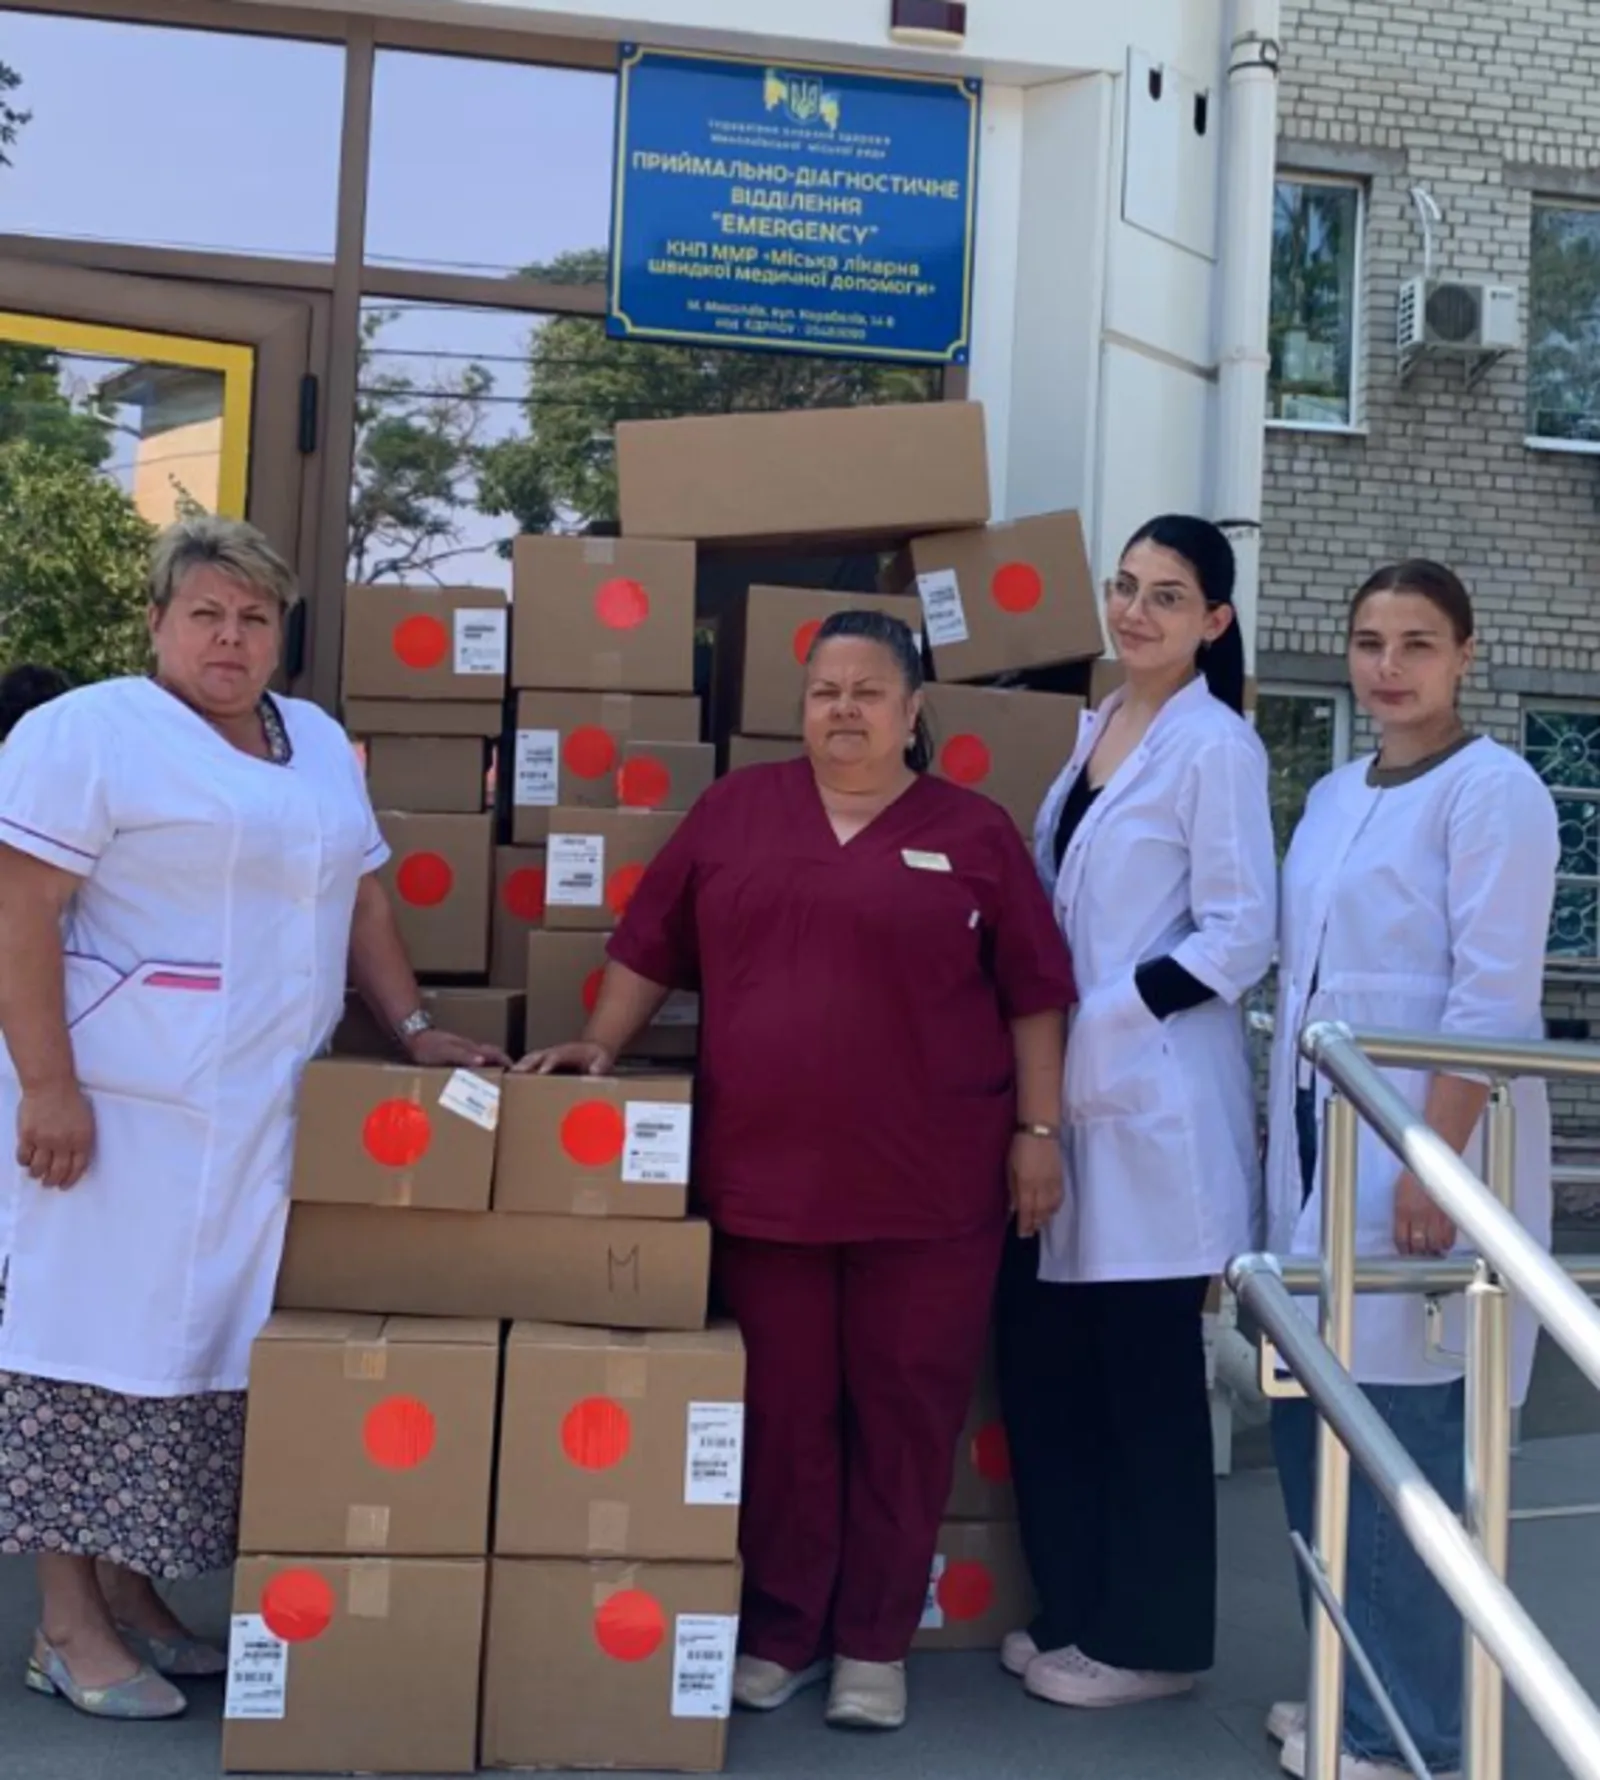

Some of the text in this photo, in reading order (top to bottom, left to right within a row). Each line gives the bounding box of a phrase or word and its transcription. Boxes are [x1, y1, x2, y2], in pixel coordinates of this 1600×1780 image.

[632, 150, 960, 199] ПРИЙМАЛЬНО-ДІАГНОСТИЧНЕ
[731, 186, 862, 216] ВІДДІЛЕННЯ
[712, 211, 879, 245] "EMERGENCY"
[647, 257, 732, 280] швидкої
[735, 266, 828, 287] медичної
[666, 239, 708, 258] КНП
[711, 243, 759, 262] ММР
[842, 254, 920, 278] лікарня
